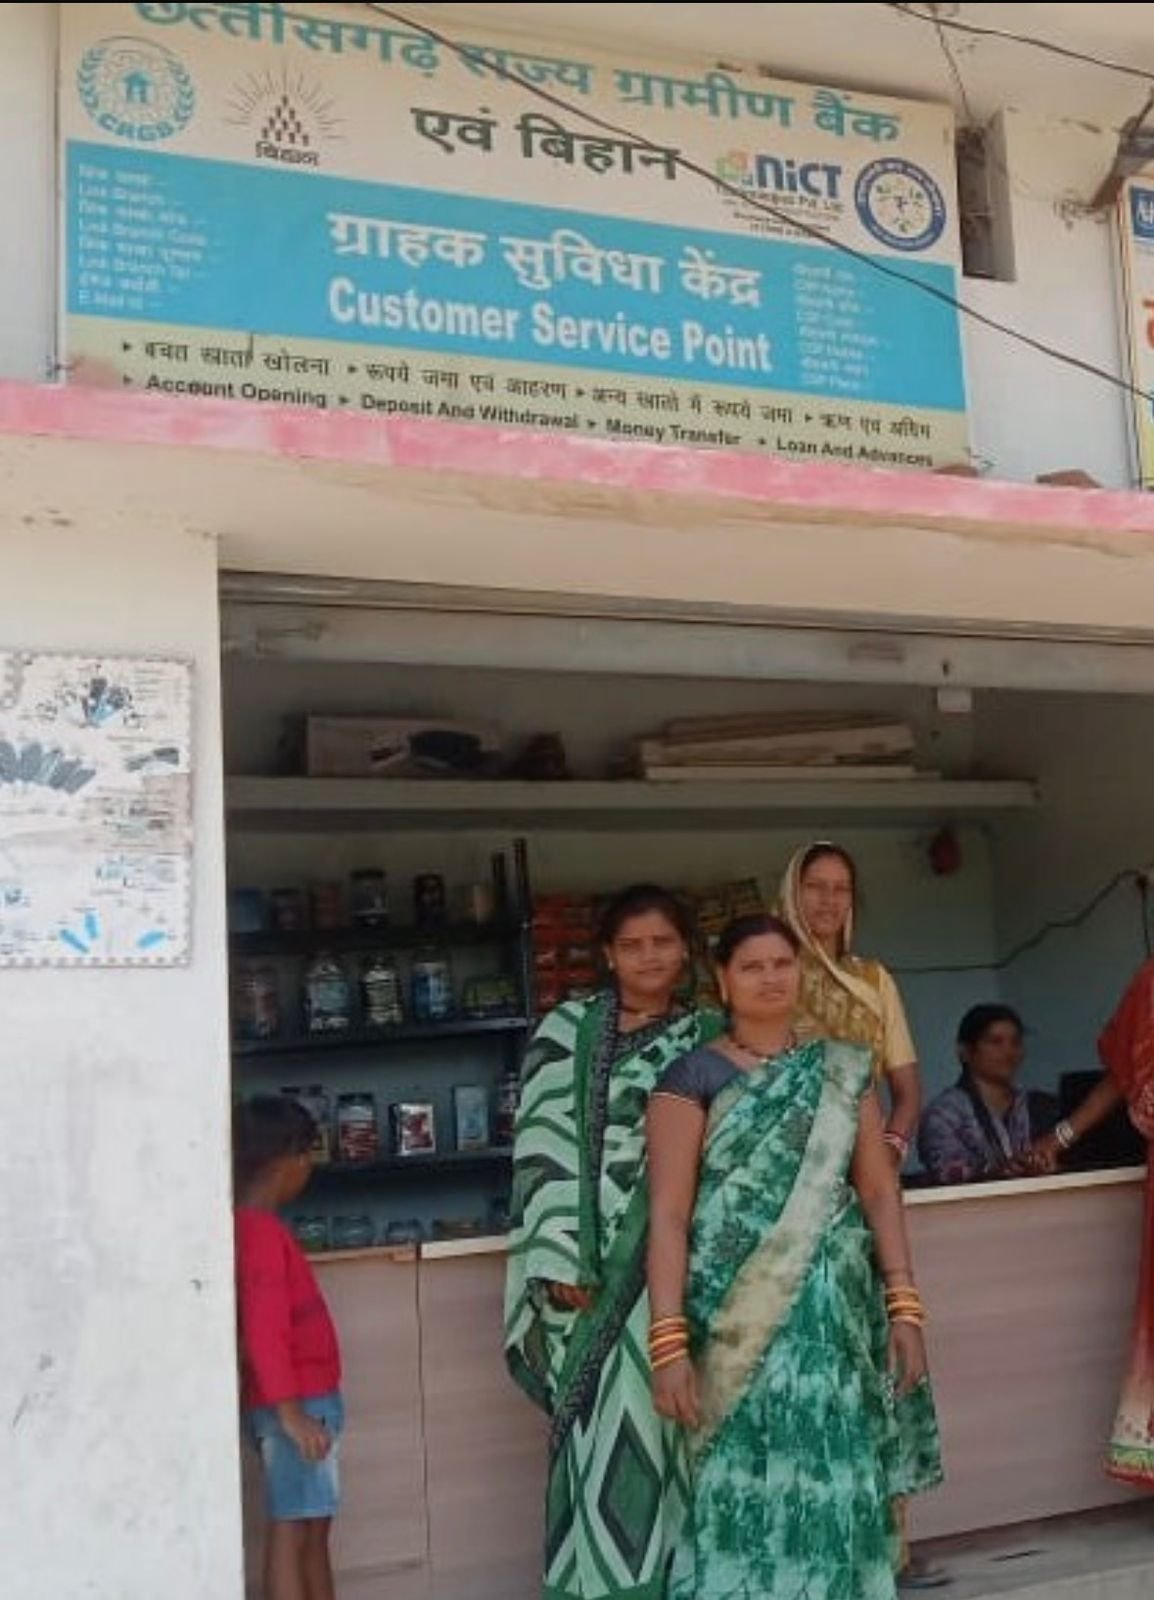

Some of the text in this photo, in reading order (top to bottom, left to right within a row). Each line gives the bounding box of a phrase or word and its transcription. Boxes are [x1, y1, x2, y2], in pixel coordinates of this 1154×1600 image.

[457, 41, 595, 94] राज्य
[614, 69, 794, 127] ग्रामीण
[812, 88, 901, 142] बैंक
[410, 107, 680, 181] एवं बिहान
[327, 211, 762, 308] ग्राहक सुविधा केंद्र
[329, 278, 773, 373] Customer Service Point
[145, 374, 326, 408] Account Opening
[362, 394, 579, 429] Deposit And Withdrawal
[606, 418, 742, 446] Money Transfer
[776, 437, 817, 455] Loan
[822, 441, 853, 459] And
